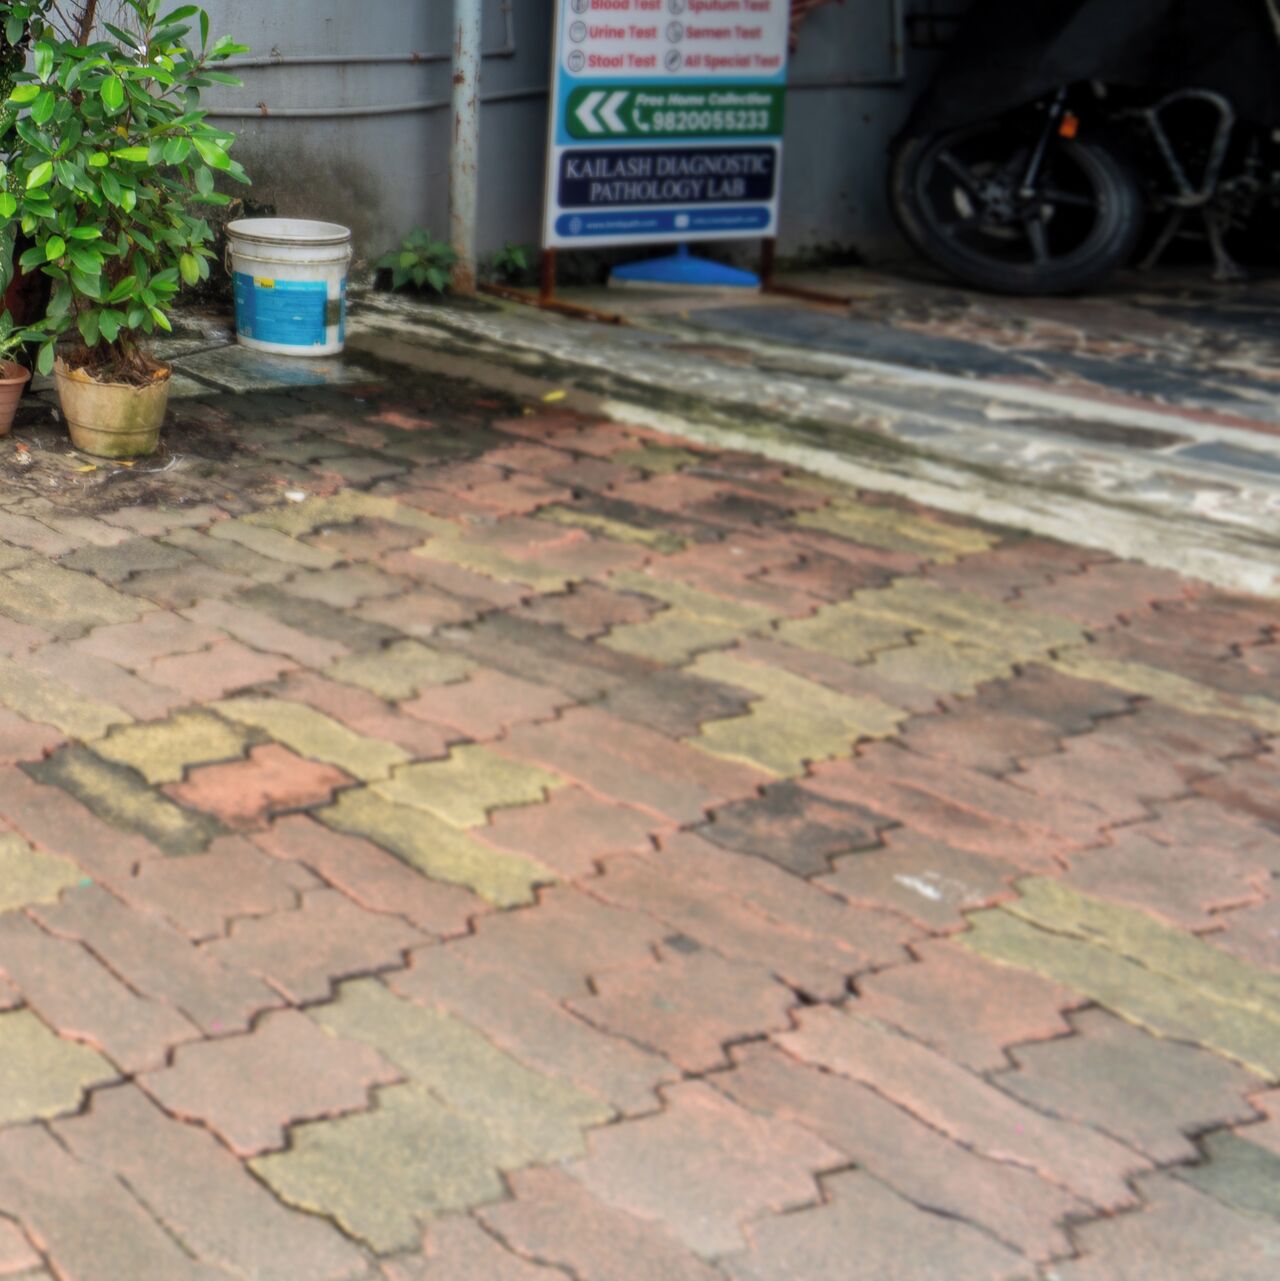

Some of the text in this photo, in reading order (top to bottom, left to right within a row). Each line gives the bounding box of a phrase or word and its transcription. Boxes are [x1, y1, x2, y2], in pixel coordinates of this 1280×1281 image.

[589, 25, 657, 40] Urine Test
[685, 26, 763, 41] Semen Test
[588, 55, 657, 68] Stool Test
[684, 54, 781, 70] All Special Test
[635, 91, 772, 106] Free Home Collection
[564, 153, 771, 179] KAILASH DIAGNOSTIC
[589, 178, 746, 201] PATHOLOGY LAB
